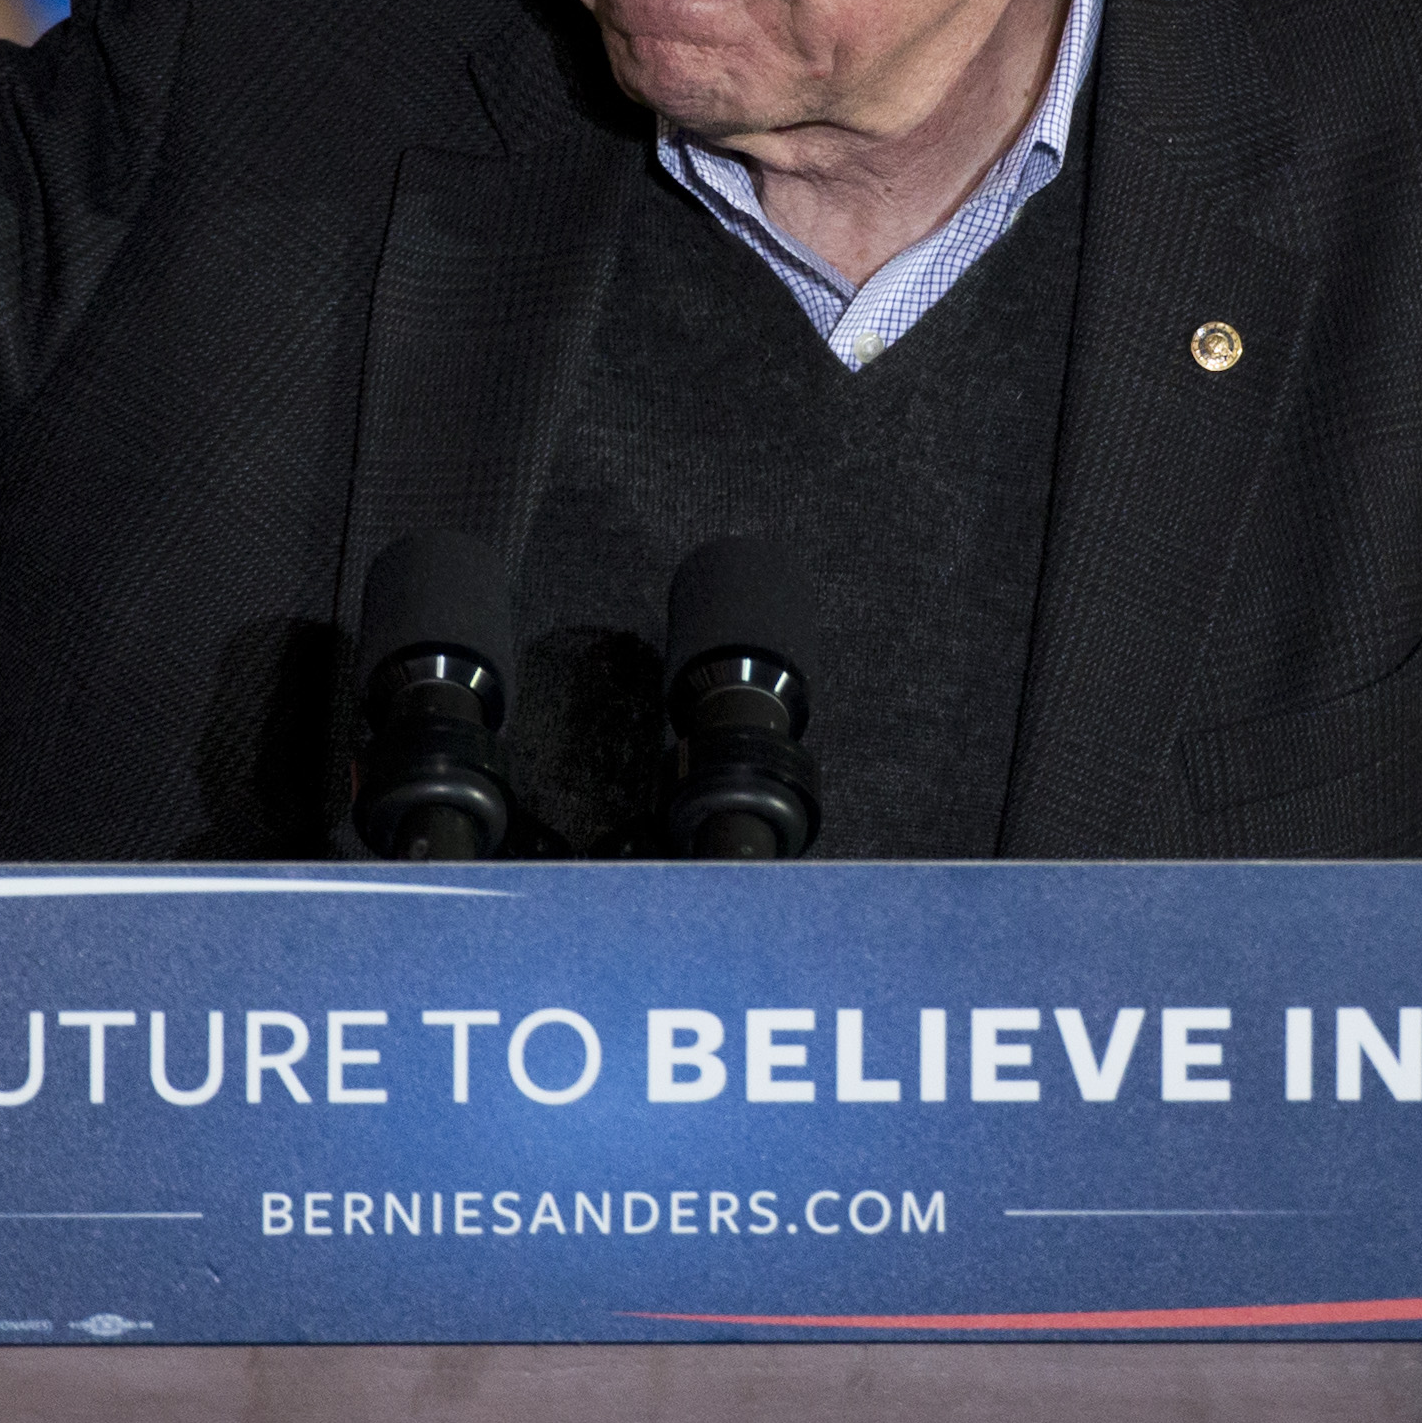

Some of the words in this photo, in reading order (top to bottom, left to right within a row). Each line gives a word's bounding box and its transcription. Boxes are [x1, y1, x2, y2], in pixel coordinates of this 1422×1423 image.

[422, 1007, 604, 1106] TO
[646, 1008, 1232, 1103] BELIEVE
[262, 1190, 948, 1236] BERNIESANDERS.COM
